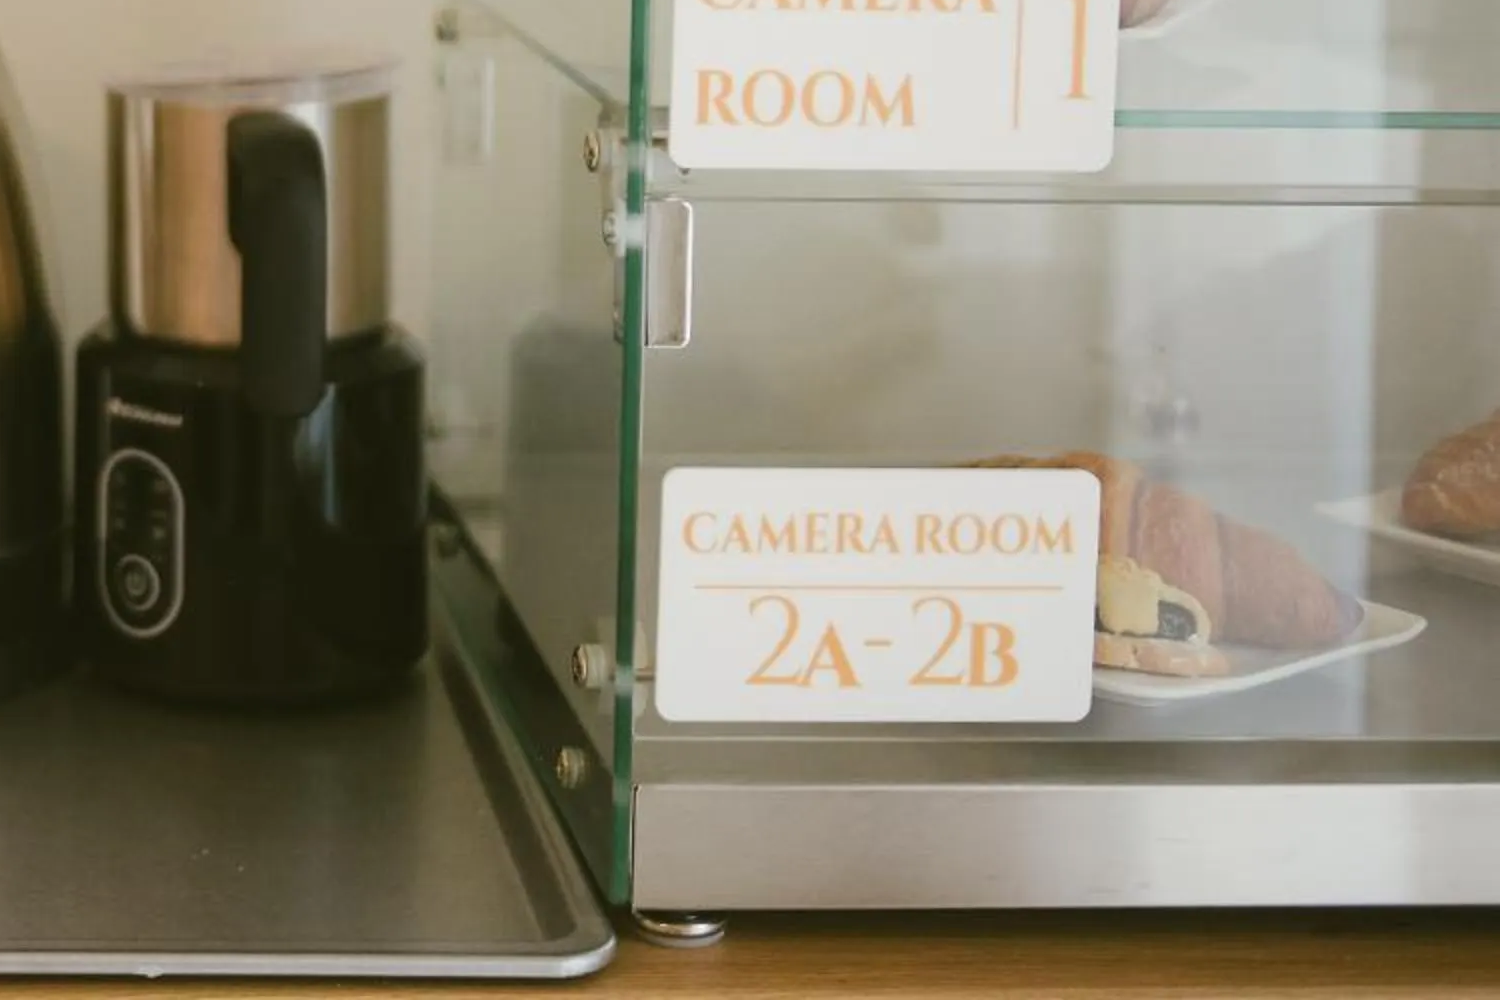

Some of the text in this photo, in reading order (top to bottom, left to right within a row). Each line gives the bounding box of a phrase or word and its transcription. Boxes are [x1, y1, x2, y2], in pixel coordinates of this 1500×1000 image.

[695, 67, 917, 129] ROOM
[681, 510, 1075, 557] CAMERA ROOM
